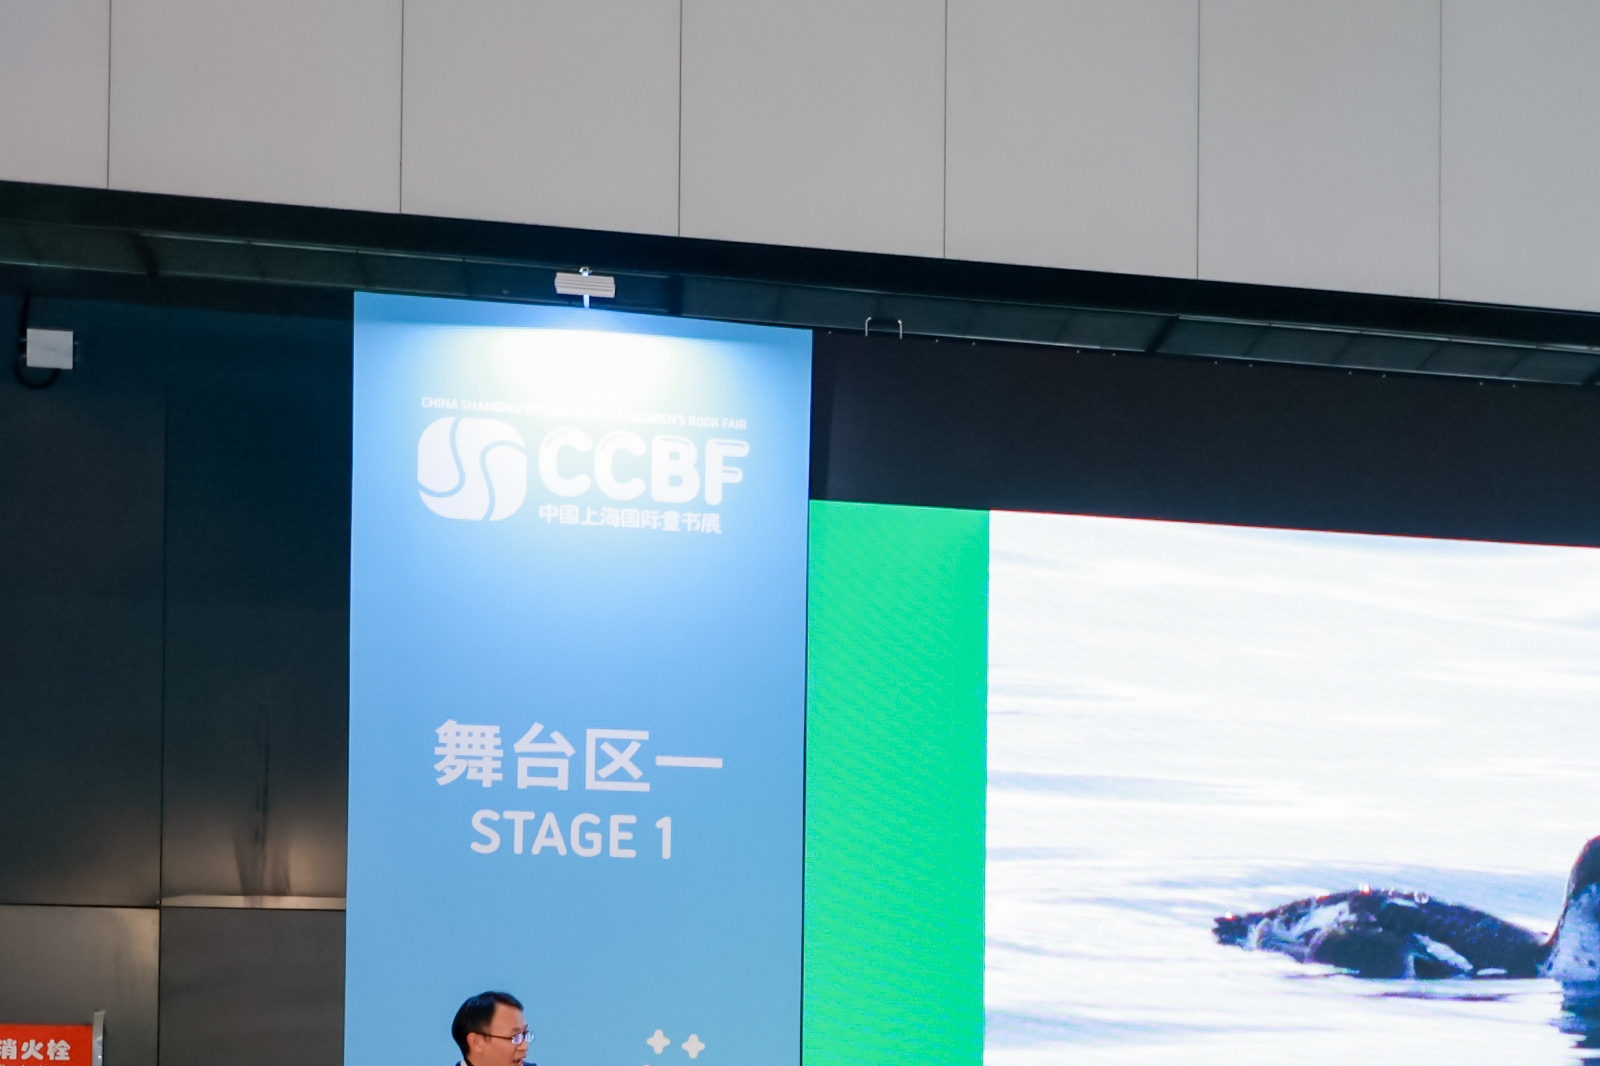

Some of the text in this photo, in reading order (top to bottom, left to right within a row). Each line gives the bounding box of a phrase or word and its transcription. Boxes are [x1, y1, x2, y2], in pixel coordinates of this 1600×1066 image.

[421, 396, 459, 410] CHINA
[688, 415, 720, 429] BOOK
[722, 417, 747, 431] FAIR
[538, 426, 750, 506] CCBF
[538, 504, 722, 533] 中国上海国际童书展
[433, 719, 723, 792] 舞台区一
[470, 809, 673, 859] STAGE 1
[0, 1038, 71, 1060] 消火栓
